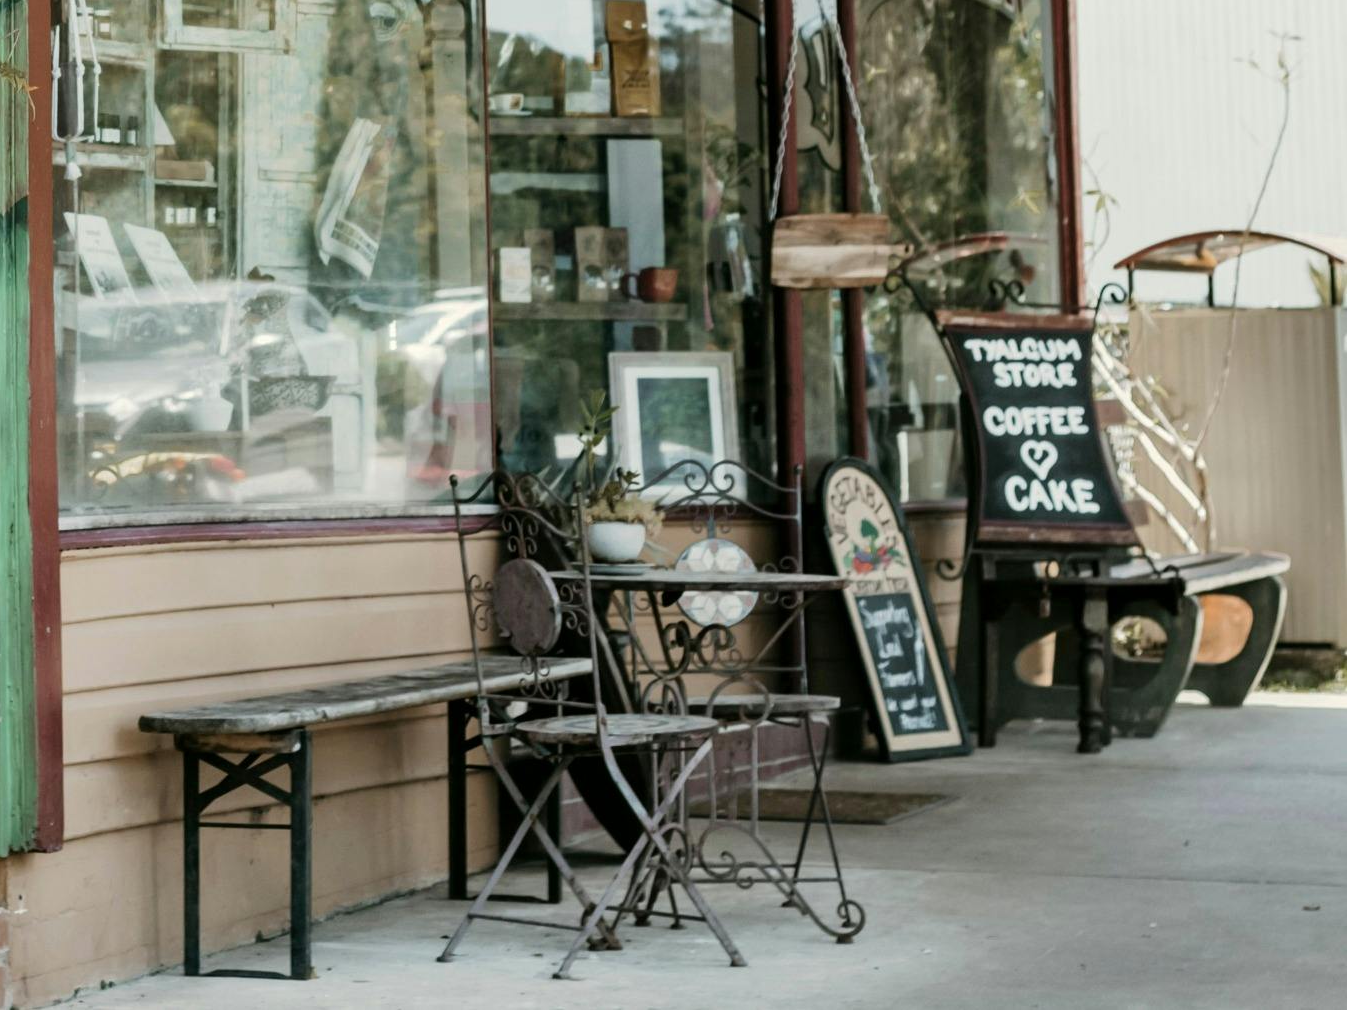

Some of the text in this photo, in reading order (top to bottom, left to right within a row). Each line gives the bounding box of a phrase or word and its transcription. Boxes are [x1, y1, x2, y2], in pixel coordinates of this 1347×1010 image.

[964, 337, 1083, 362] TYALGUM
[993, 362, 1078, 389] STORE
[983, 406, 1090, 437] COFFEE
[1004, 475, 1101, 514] CAKE
